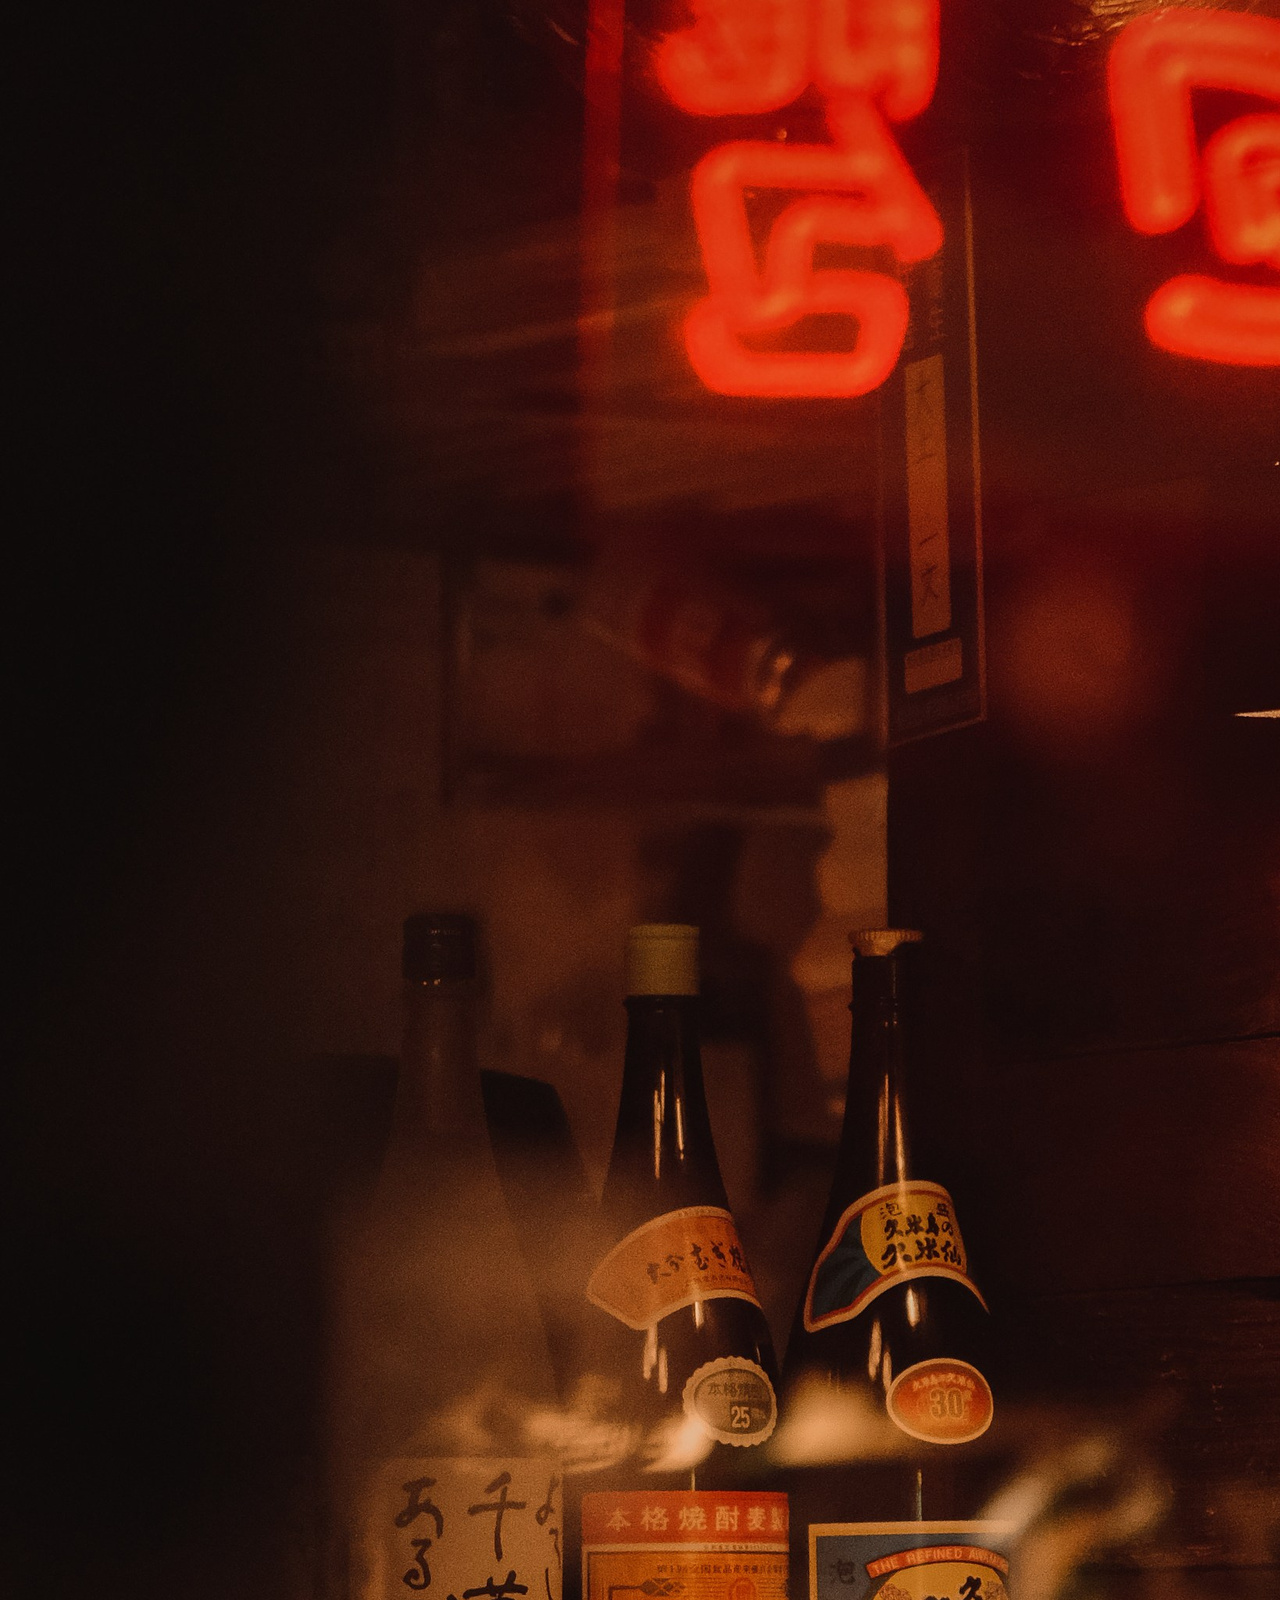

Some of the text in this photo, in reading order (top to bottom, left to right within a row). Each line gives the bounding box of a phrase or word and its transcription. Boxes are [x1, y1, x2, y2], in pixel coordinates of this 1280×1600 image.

[883, 1212, 955, 1241] 久米島の
[879, 1239, 963, 1270] 久米仙
[731, 1405, 751, 1429] 25
[873, 1557, 898, 1575] THE
[906, 1548, 964, 1564] REFINED
